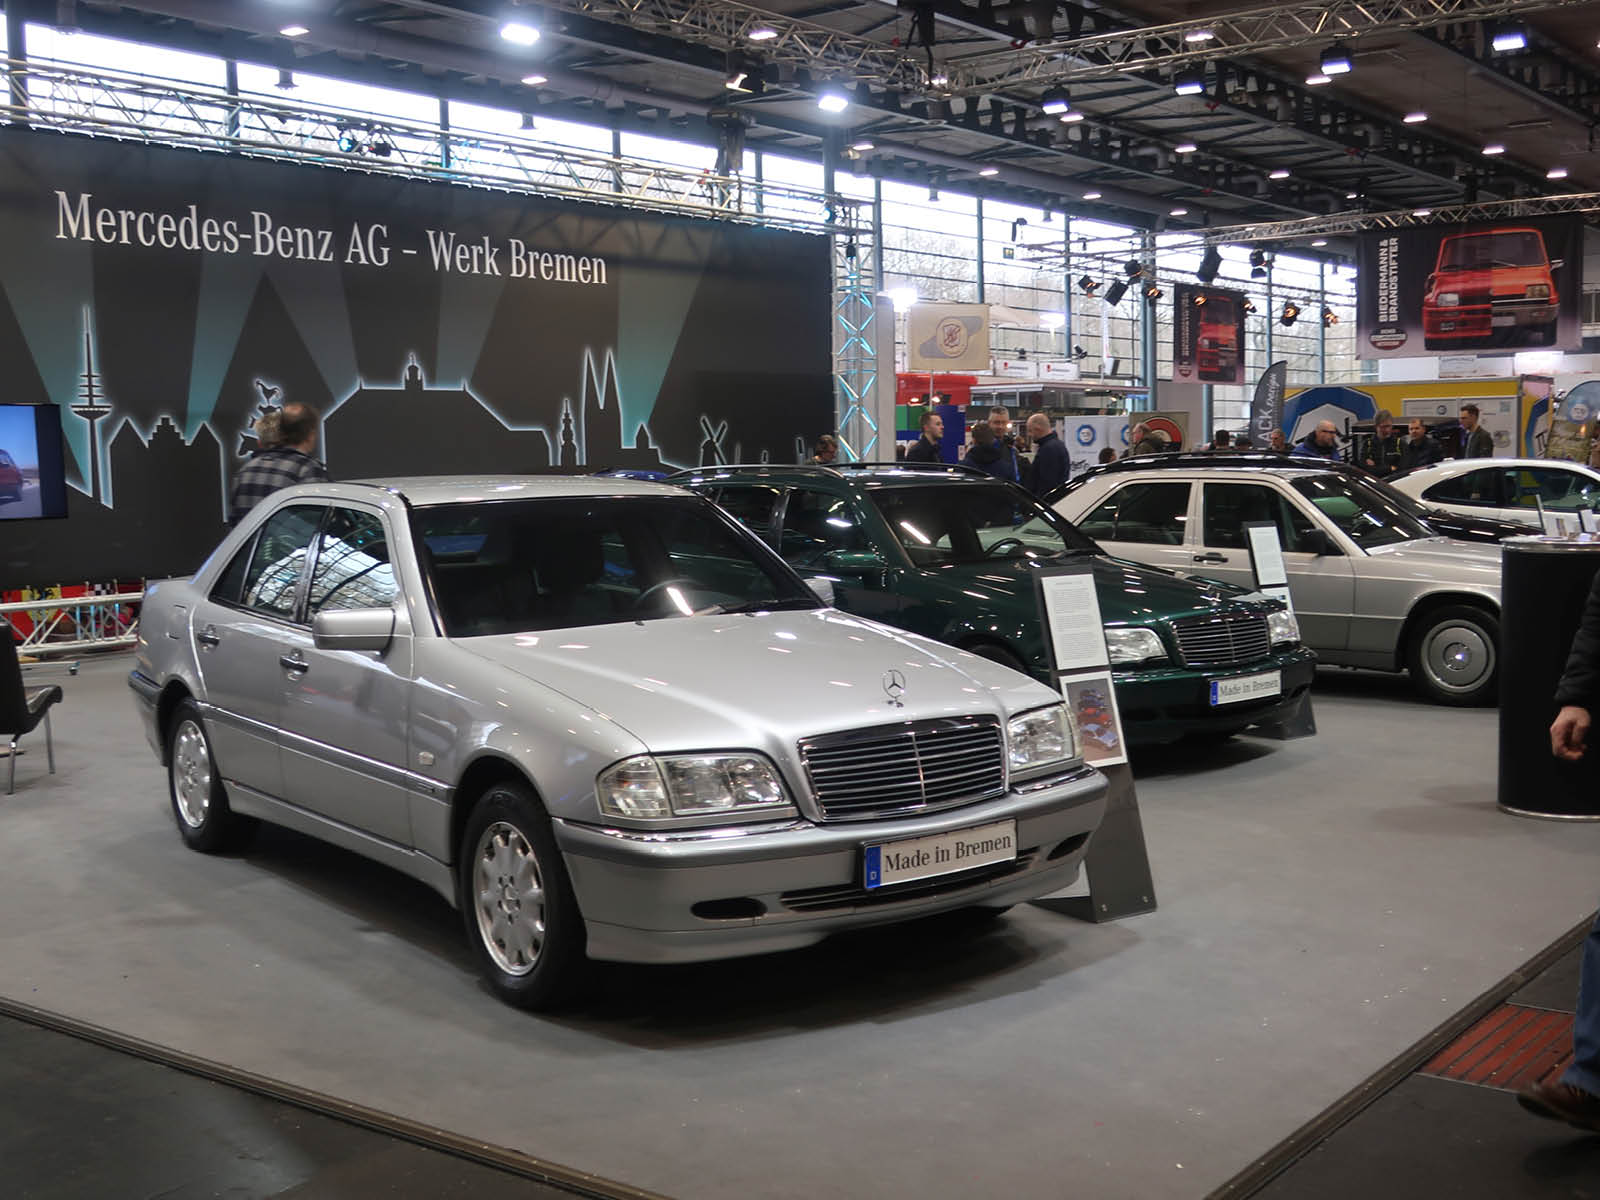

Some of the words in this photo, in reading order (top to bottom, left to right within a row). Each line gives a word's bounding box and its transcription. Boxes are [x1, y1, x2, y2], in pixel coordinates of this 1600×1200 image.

[54, 190, 335, 262] Mercedes-Benz
[344, 222, 391, 266] AG
[425, 229, 502, 277] Werk
[508, 238, 609, 285] Bremen
[1378, 247, 1389, 322] BIEDERMANN
[1388, 237, 1399, 322] BRANDSTIFTER
[1258, 408, 1273, 446] ACK
[885, 850, 930, 872] Made
[935, 846, 950, 863] in
[955, 836, 1011, 859] Bremen
